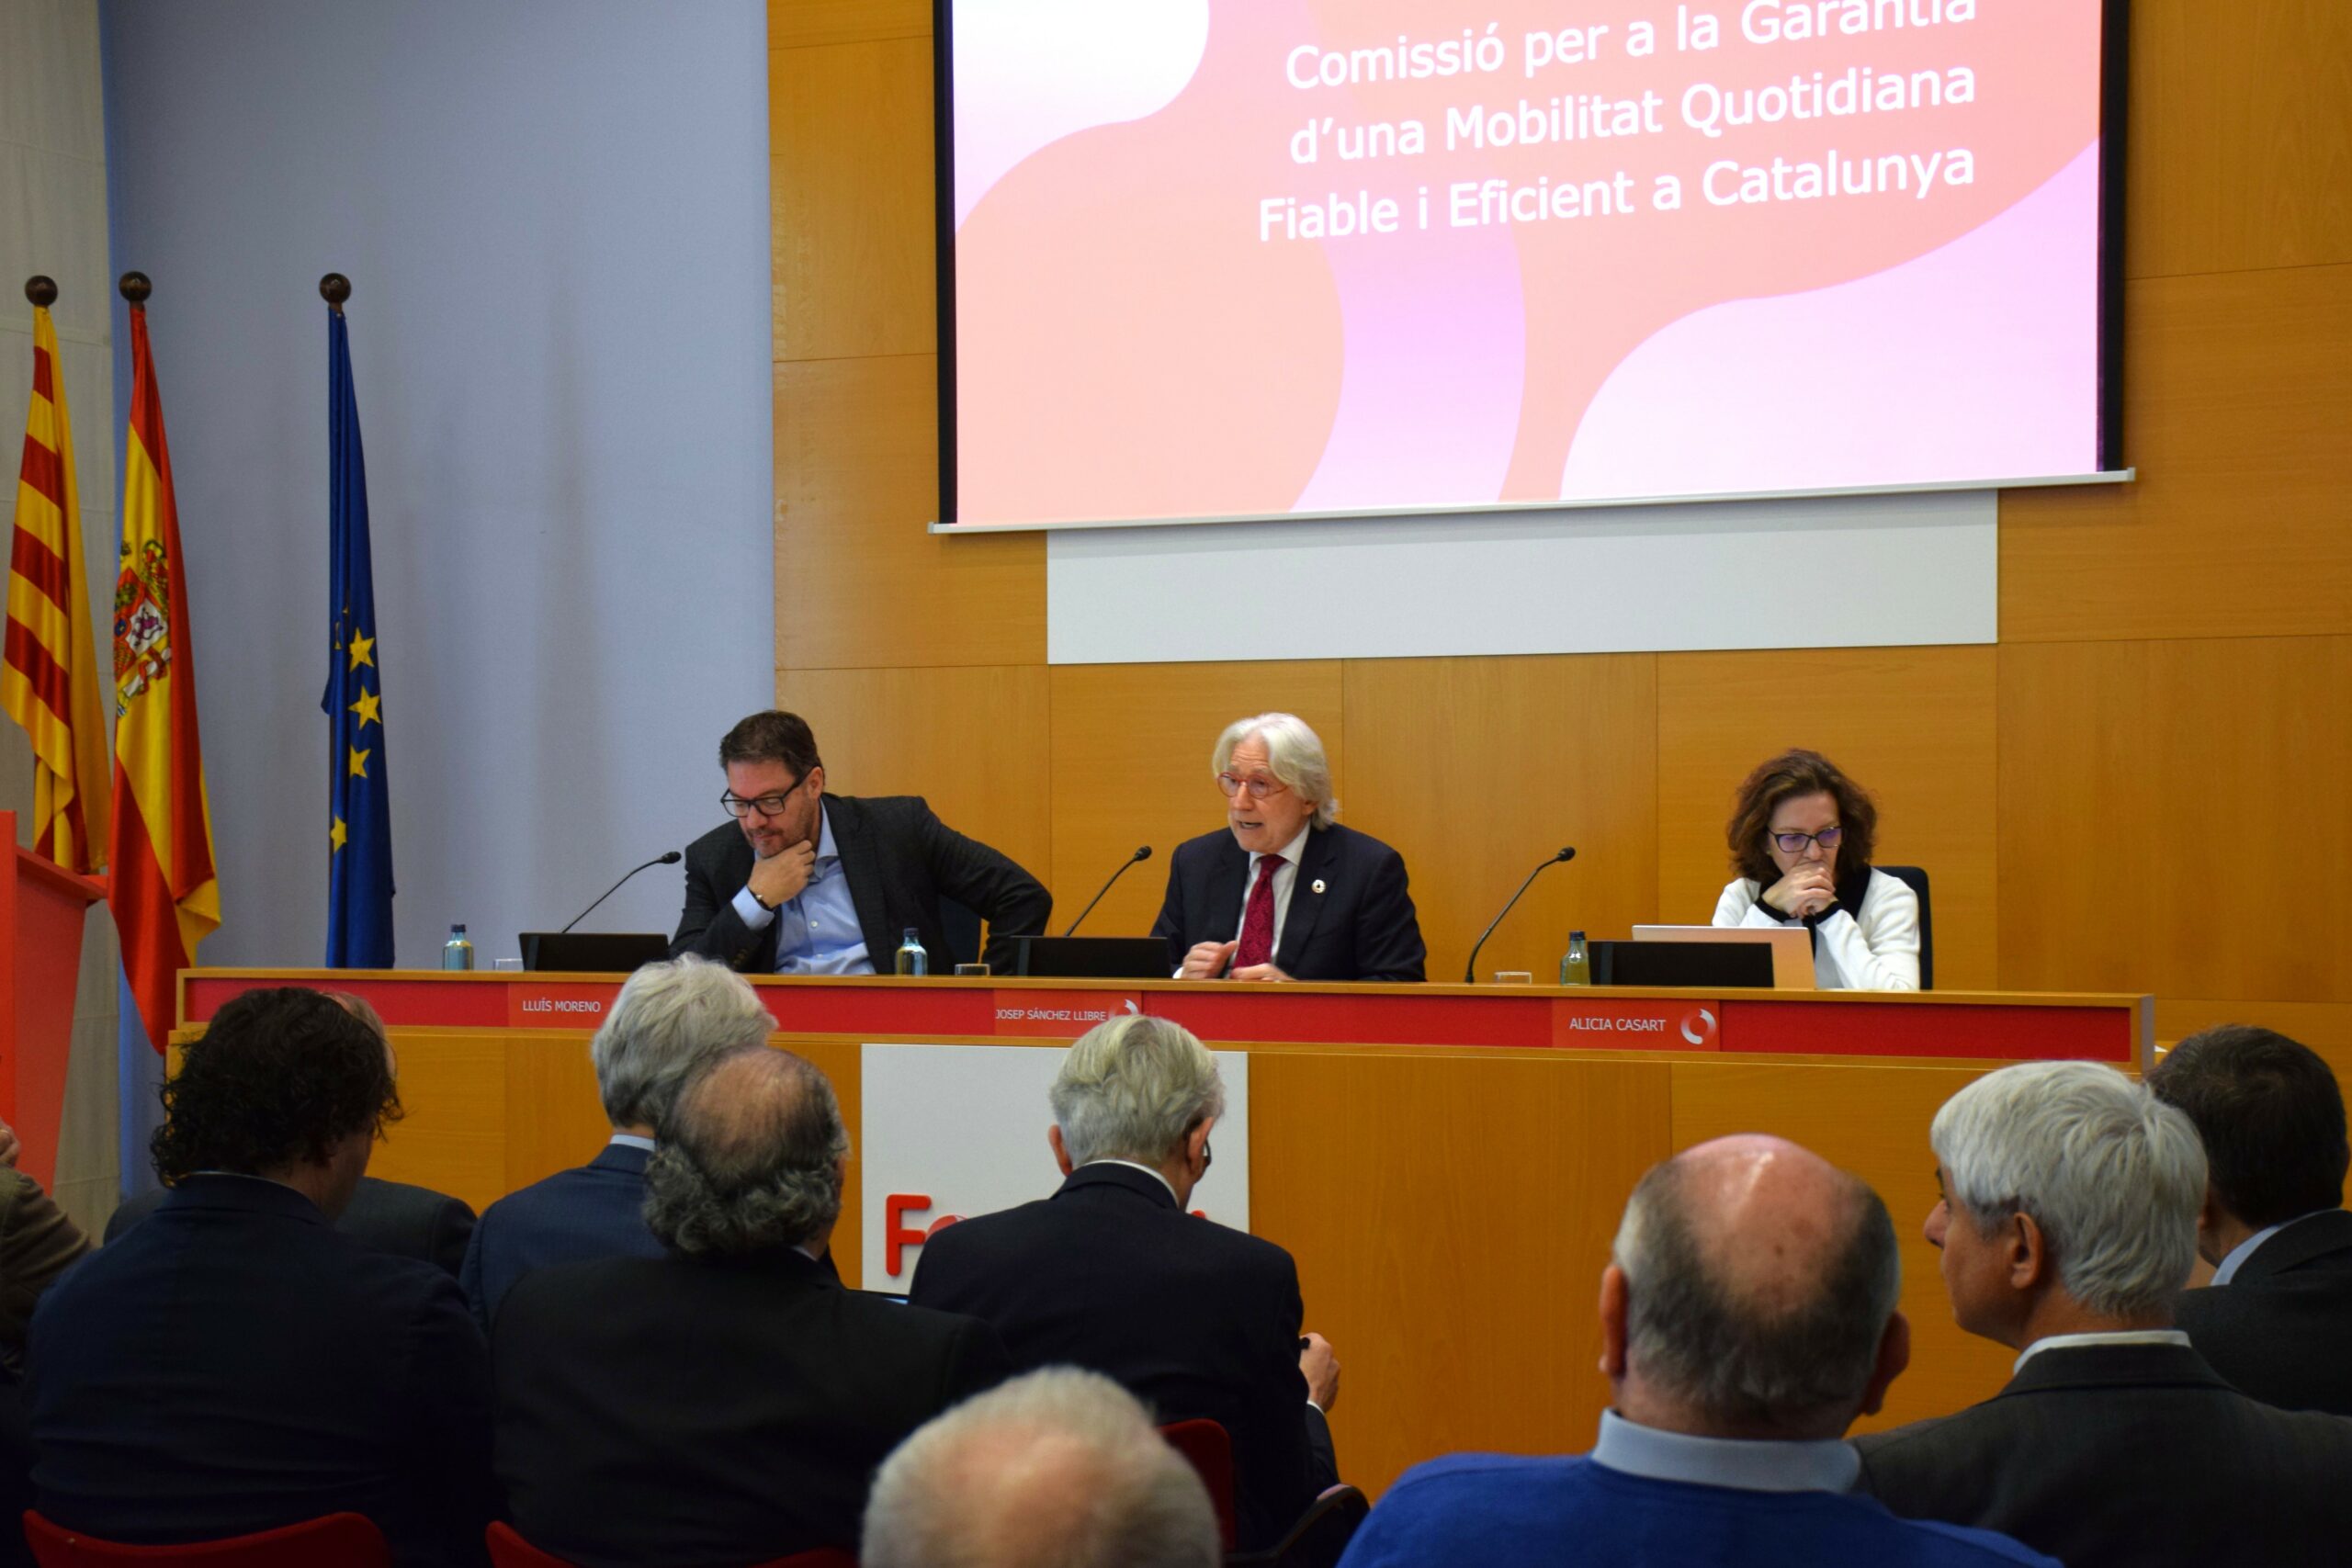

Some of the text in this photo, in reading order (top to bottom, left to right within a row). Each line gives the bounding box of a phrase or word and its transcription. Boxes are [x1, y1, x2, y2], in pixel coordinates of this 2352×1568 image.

[1286, 21, 1505, 89] Comissió
[1525, 25, 1610, 78] per
[1625, 20, 1655, 57] a
[1678, 4, 1719, 51] la
[1446, 90, 1663, 151] Mobilitat
[1681, 66, 1975, 139] Quotidiana
[1260, 149, 1974, 242] Fiable i Eficient a Catalunya
[523, 998, 601, 1012] LLUÍS MORENO
[996, 1008, 1106, 1021] JOSEP SÁNCHEZ LLIBRE
[1569, 1018, 1667, 1032] ALICIA CASART
